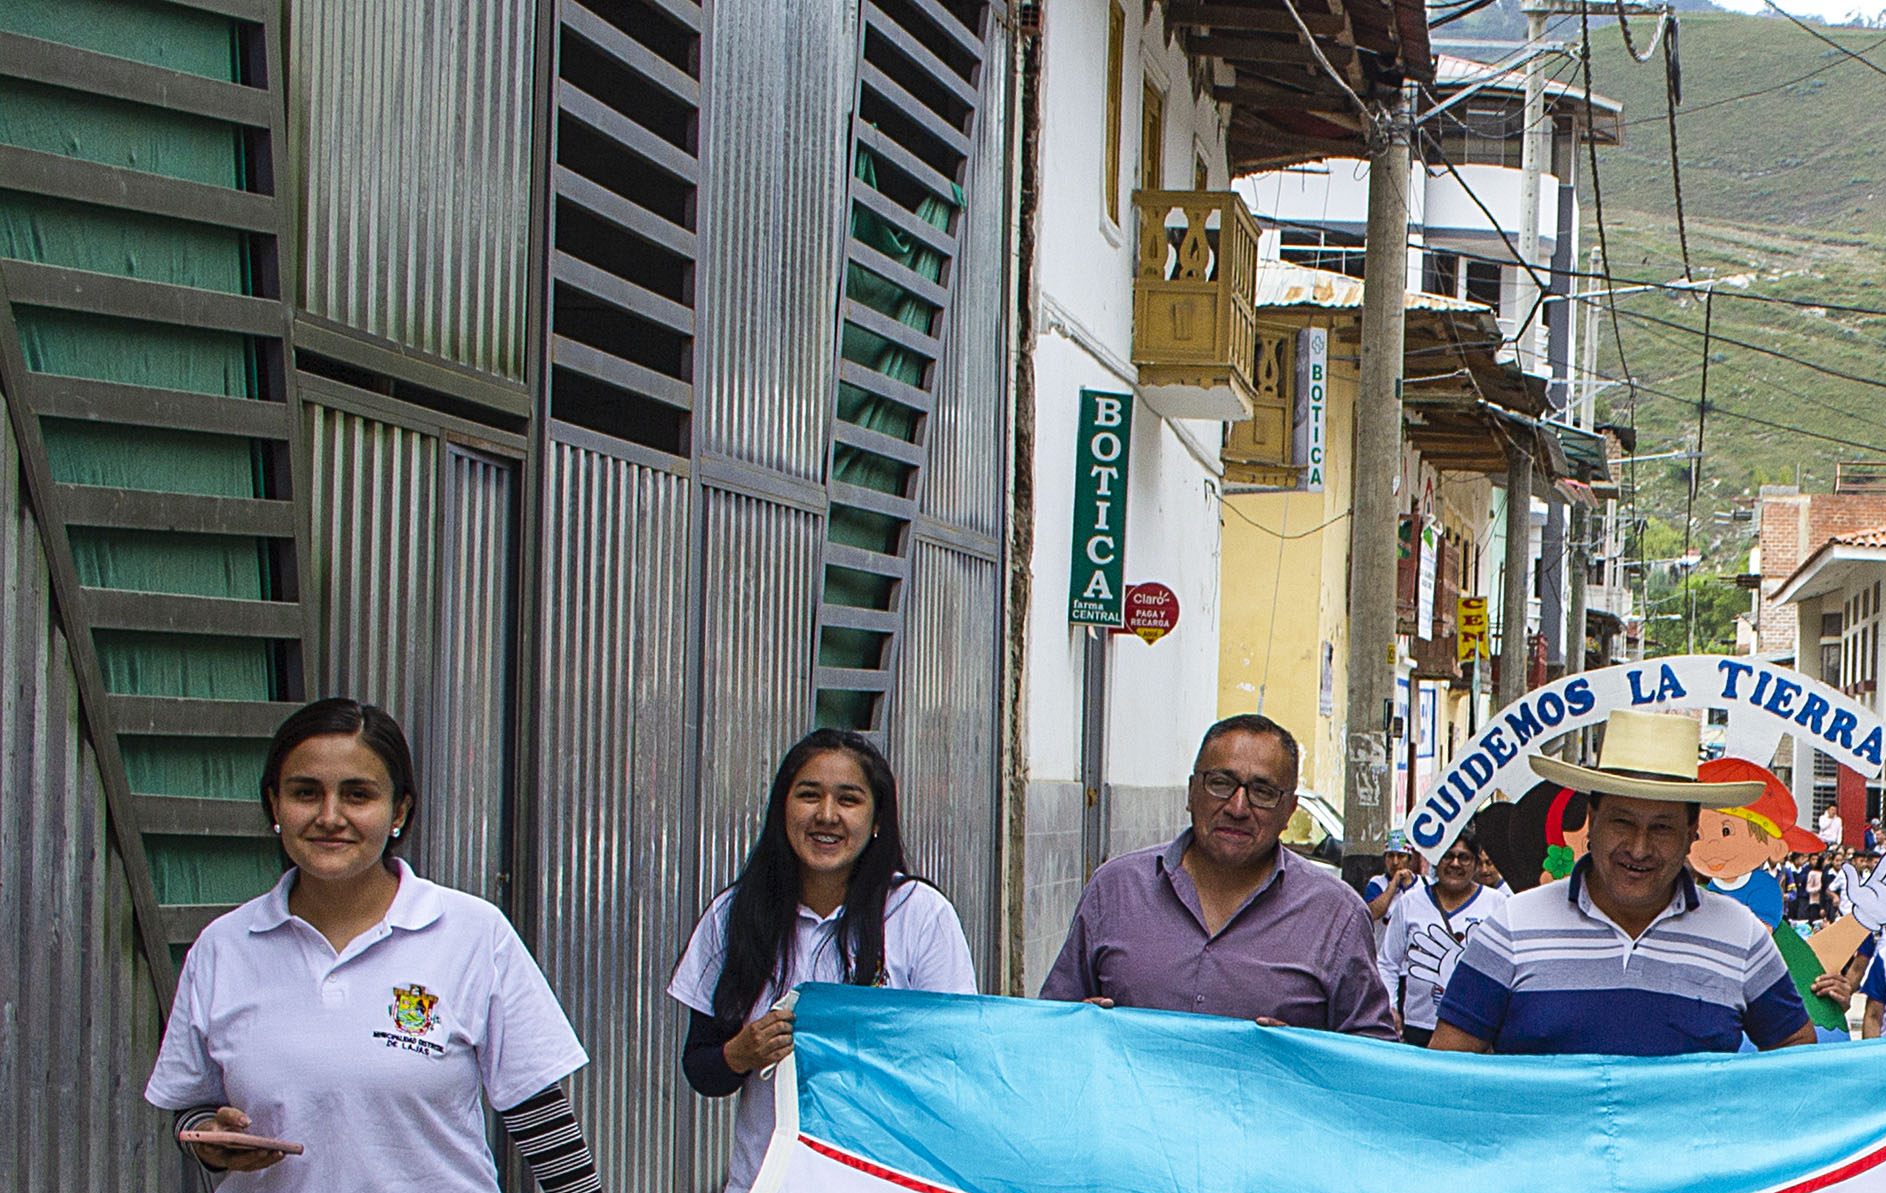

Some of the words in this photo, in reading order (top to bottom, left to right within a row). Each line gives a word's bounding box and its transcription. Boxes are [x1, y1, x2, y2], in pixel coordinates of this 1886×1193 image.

[1310, 364, 1322, 485] BOTICA
[1083, 397, 1122, 599] BOTICA
[1073, 600, 1104, 610] farma
[1133, 592, 1166, 605] Claro
[1072, 609, 1120, 622] CENTRAL
[1135, 609, 1156, 618] PAGA
[1157, 610, 1166, 618] Y
[1130, 617, 1170, 627] RECARGA
[1462, 600, 1485, 660] CENA
[1412, 678, 1596, 849] CUIDEMOS
[1626, 664, 1687, 705] LA
[1717, 659, 1882, 766] TIERRA
[402, 1042, 430, 1056] LAJAS
